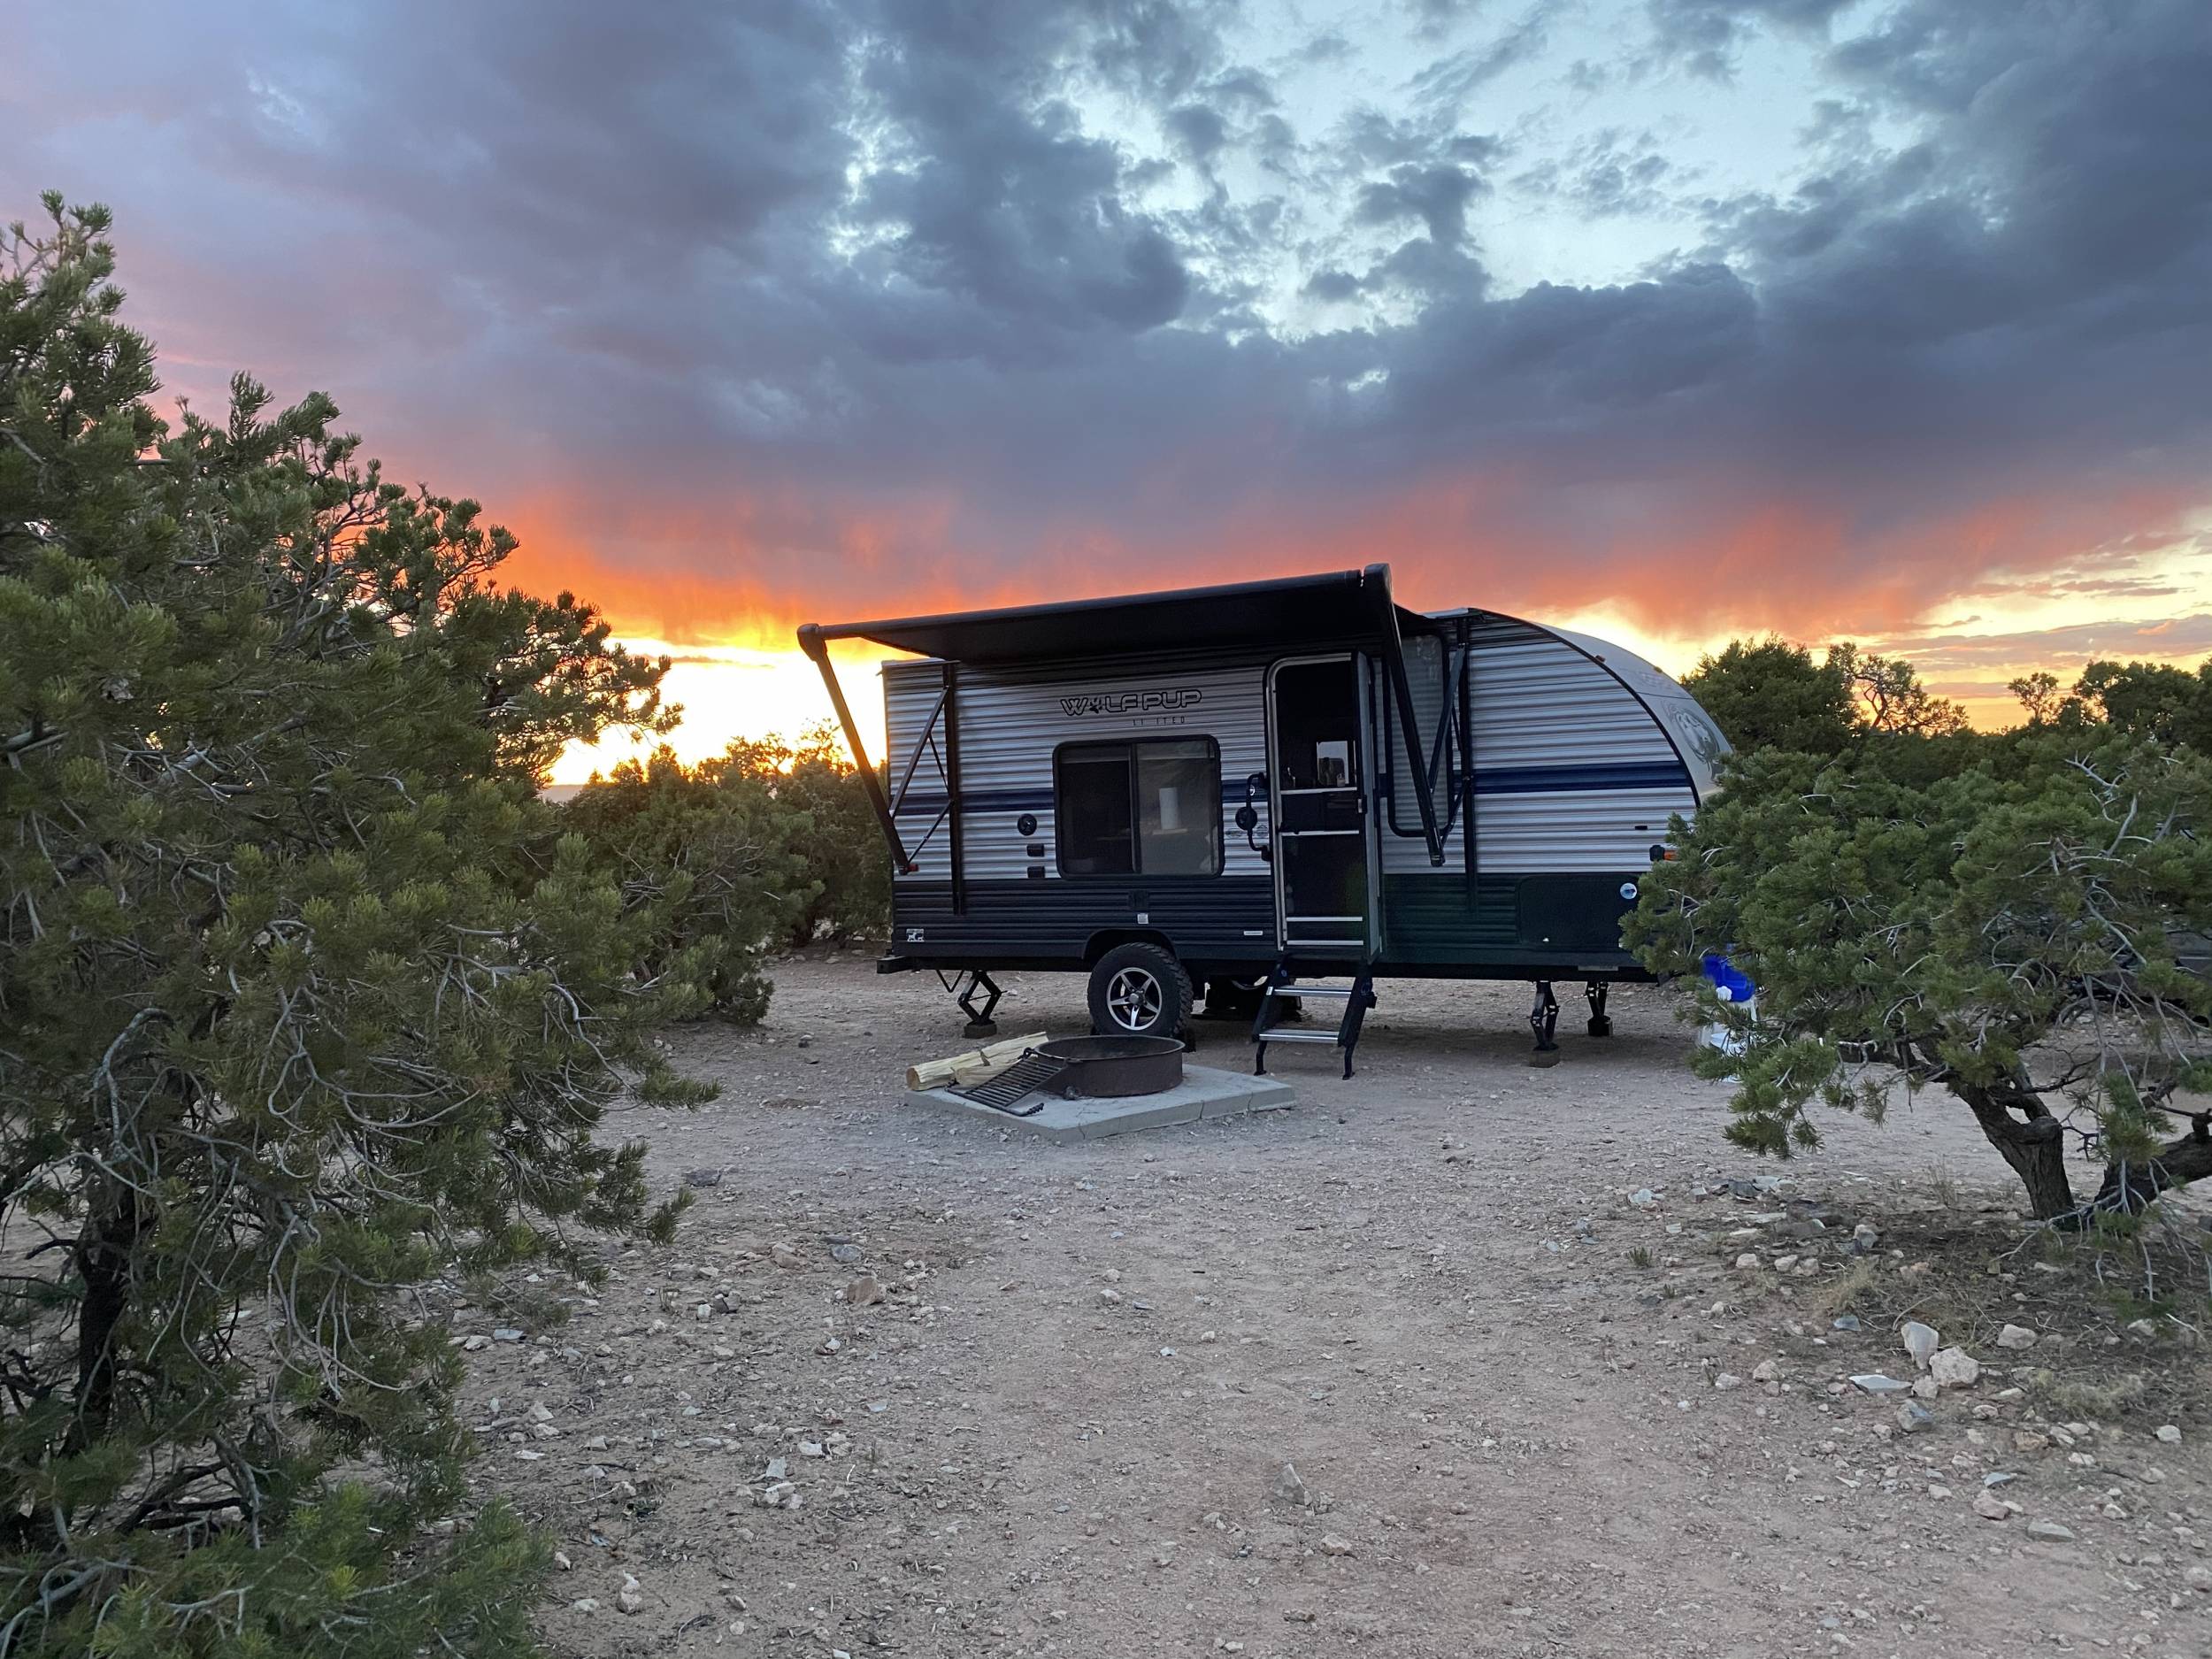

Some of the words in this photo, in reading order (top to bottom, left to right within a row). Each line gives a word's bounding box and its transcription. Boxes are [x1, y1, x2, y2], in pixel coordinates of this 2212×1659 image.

[1060, 695, 1139, 717] WLF
[1142, 689, 1202, 710] PUP
[1133, 716, 1185, 726] LIITED
